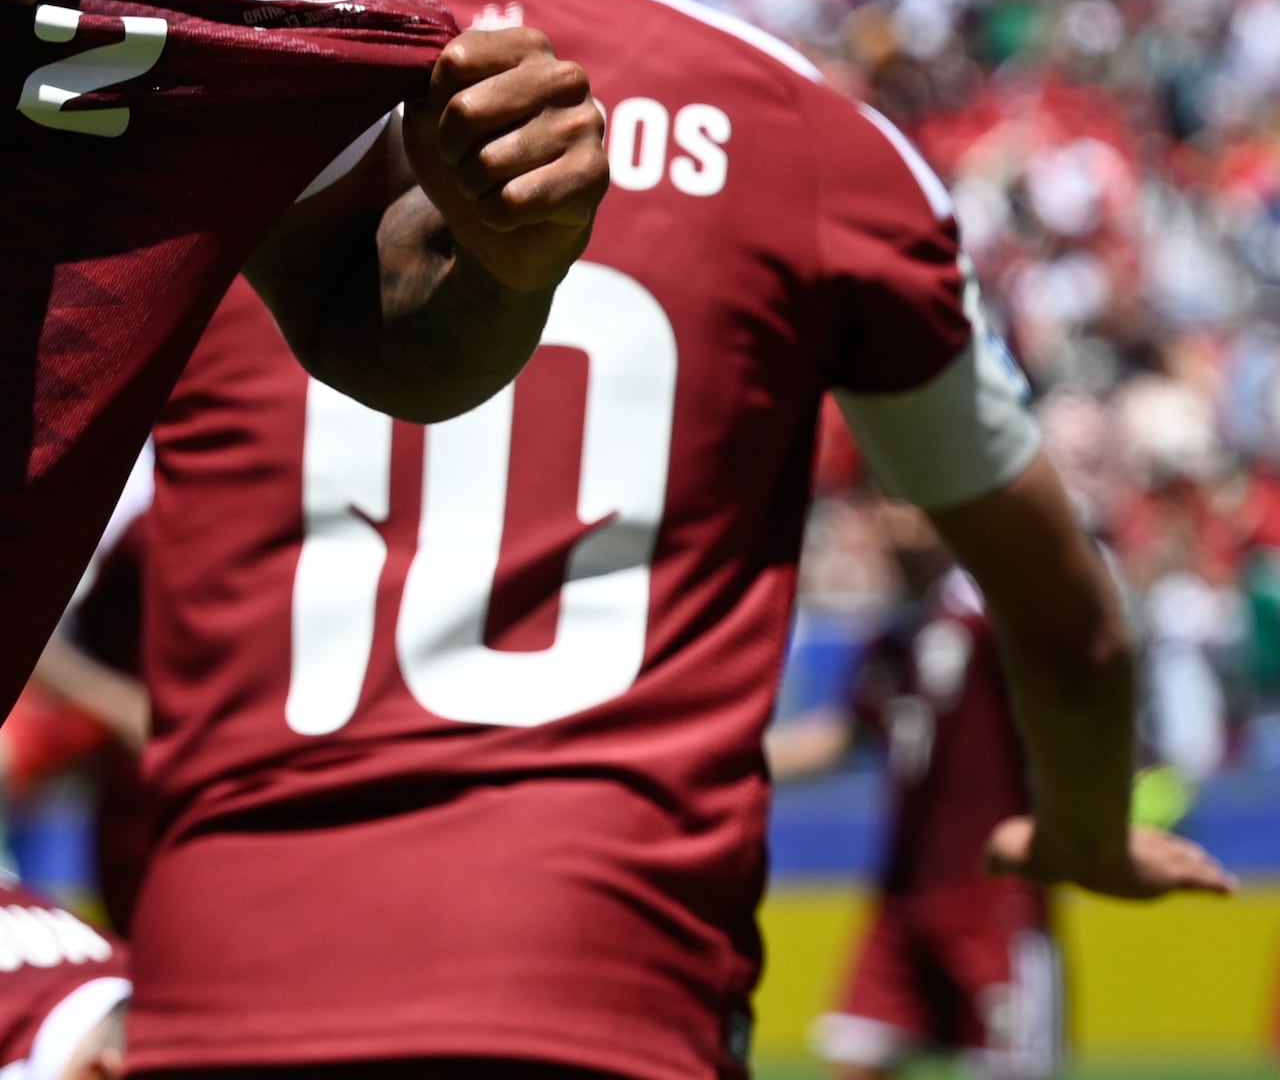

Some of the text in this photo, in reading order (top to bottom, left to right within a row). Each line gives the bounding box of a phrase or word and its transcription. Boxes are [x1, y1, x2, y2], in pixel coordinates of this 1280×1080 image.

[17, 4, 168, 137] 2
[593, 97, 732, 197] OS
[285, 260, 679, 736] 10
